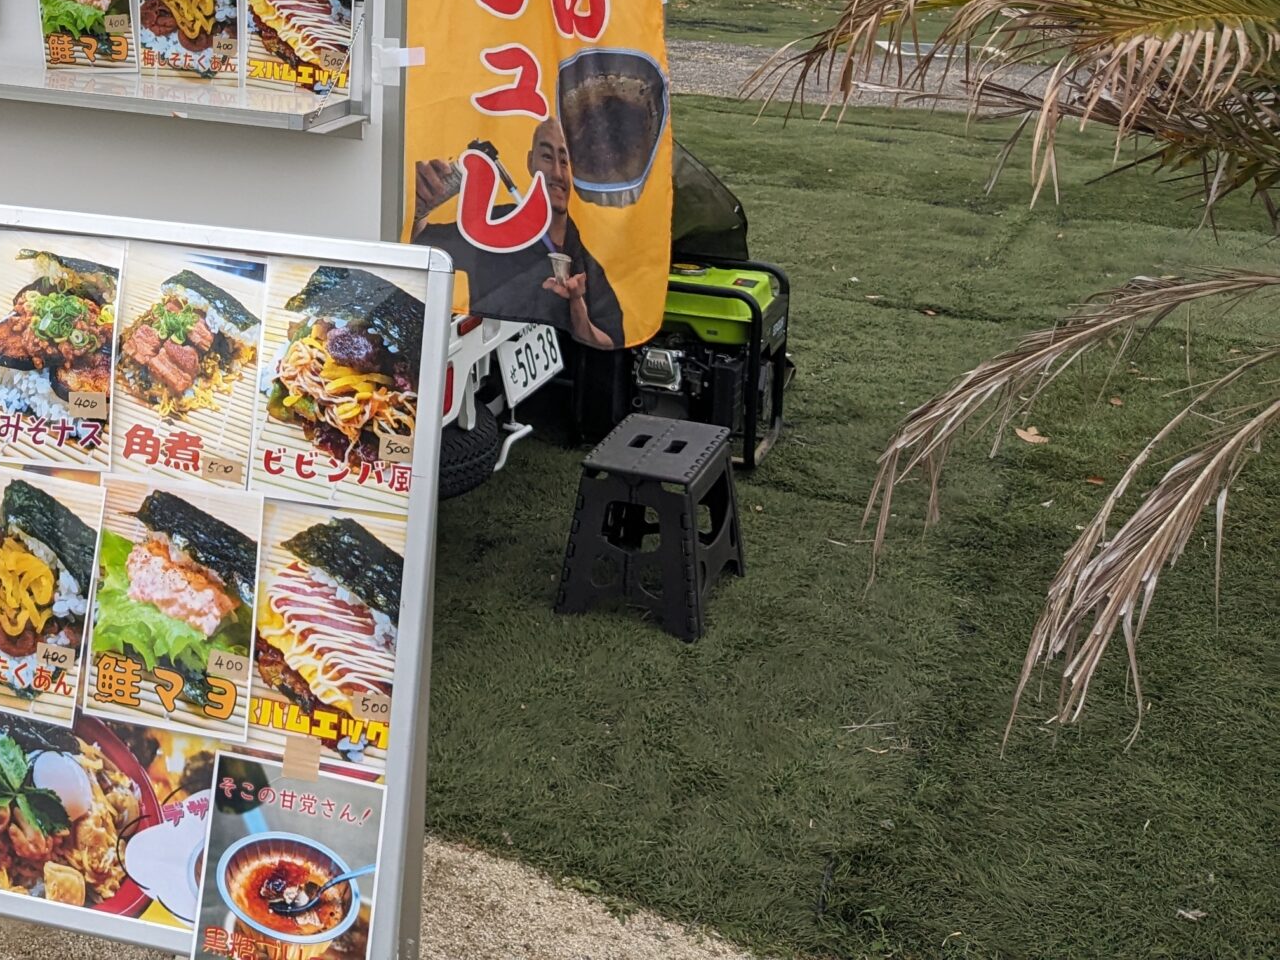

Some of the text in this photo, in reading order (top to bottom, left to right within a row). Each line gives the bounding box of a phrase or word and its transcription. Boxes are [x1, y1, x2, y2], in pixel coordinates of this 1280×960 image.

[106, 17, 125, 28] 400
[46, 32, 129, 64] 鮭マヨ
[216, 41, 233, 52] 400
[142, 49, 236, 72] 梅しそたくあん
[249, 60, 347, 89] スパムエッグ
[515, 327, 558, 388] 50-38
[122, 423, 202, 473] 角煮
[386, 440, 410, 455] 500
[208, 460, 234, 474] 500
[263, 448, 412, 495] ビビンバ風
[42, 648, 68, 665] 400
[214, 655, 244, 673] 400
[96, 653, 238, 721] 鮭マヨ
[361, 697, 388, 714] 500
